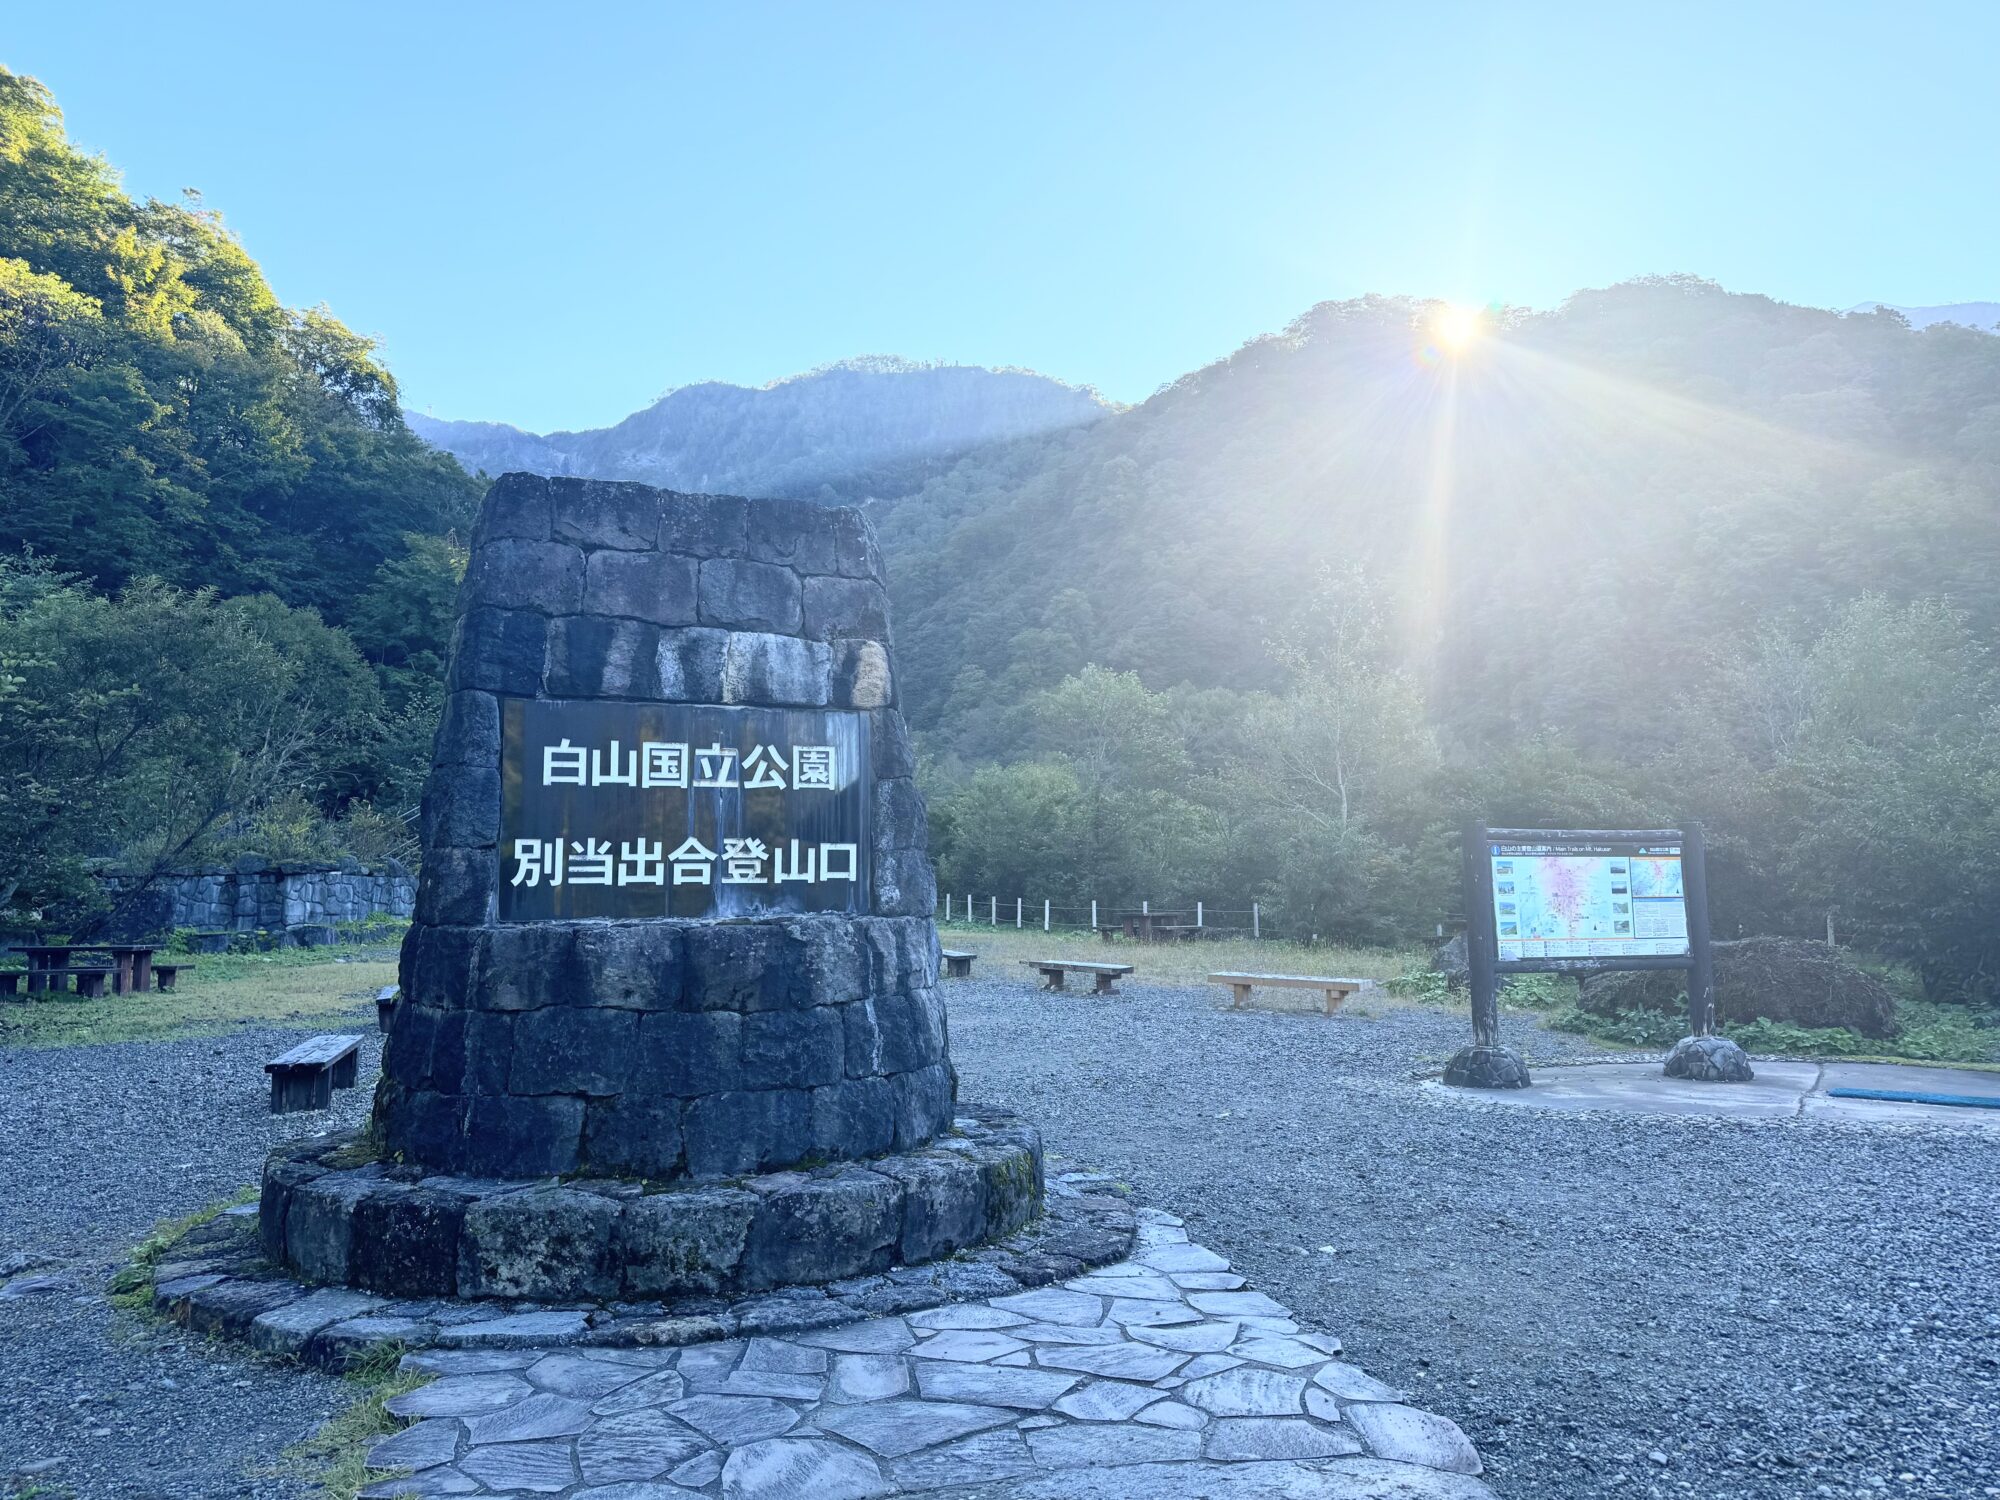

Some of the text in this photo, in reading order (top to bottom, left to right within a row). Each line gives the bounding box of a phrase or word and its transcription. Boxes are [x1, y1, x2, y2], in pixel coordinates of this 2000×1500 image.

[542, 738, 836, 791] 白山国立公園
[510, 836, 857, 887] 別当出合登山口
